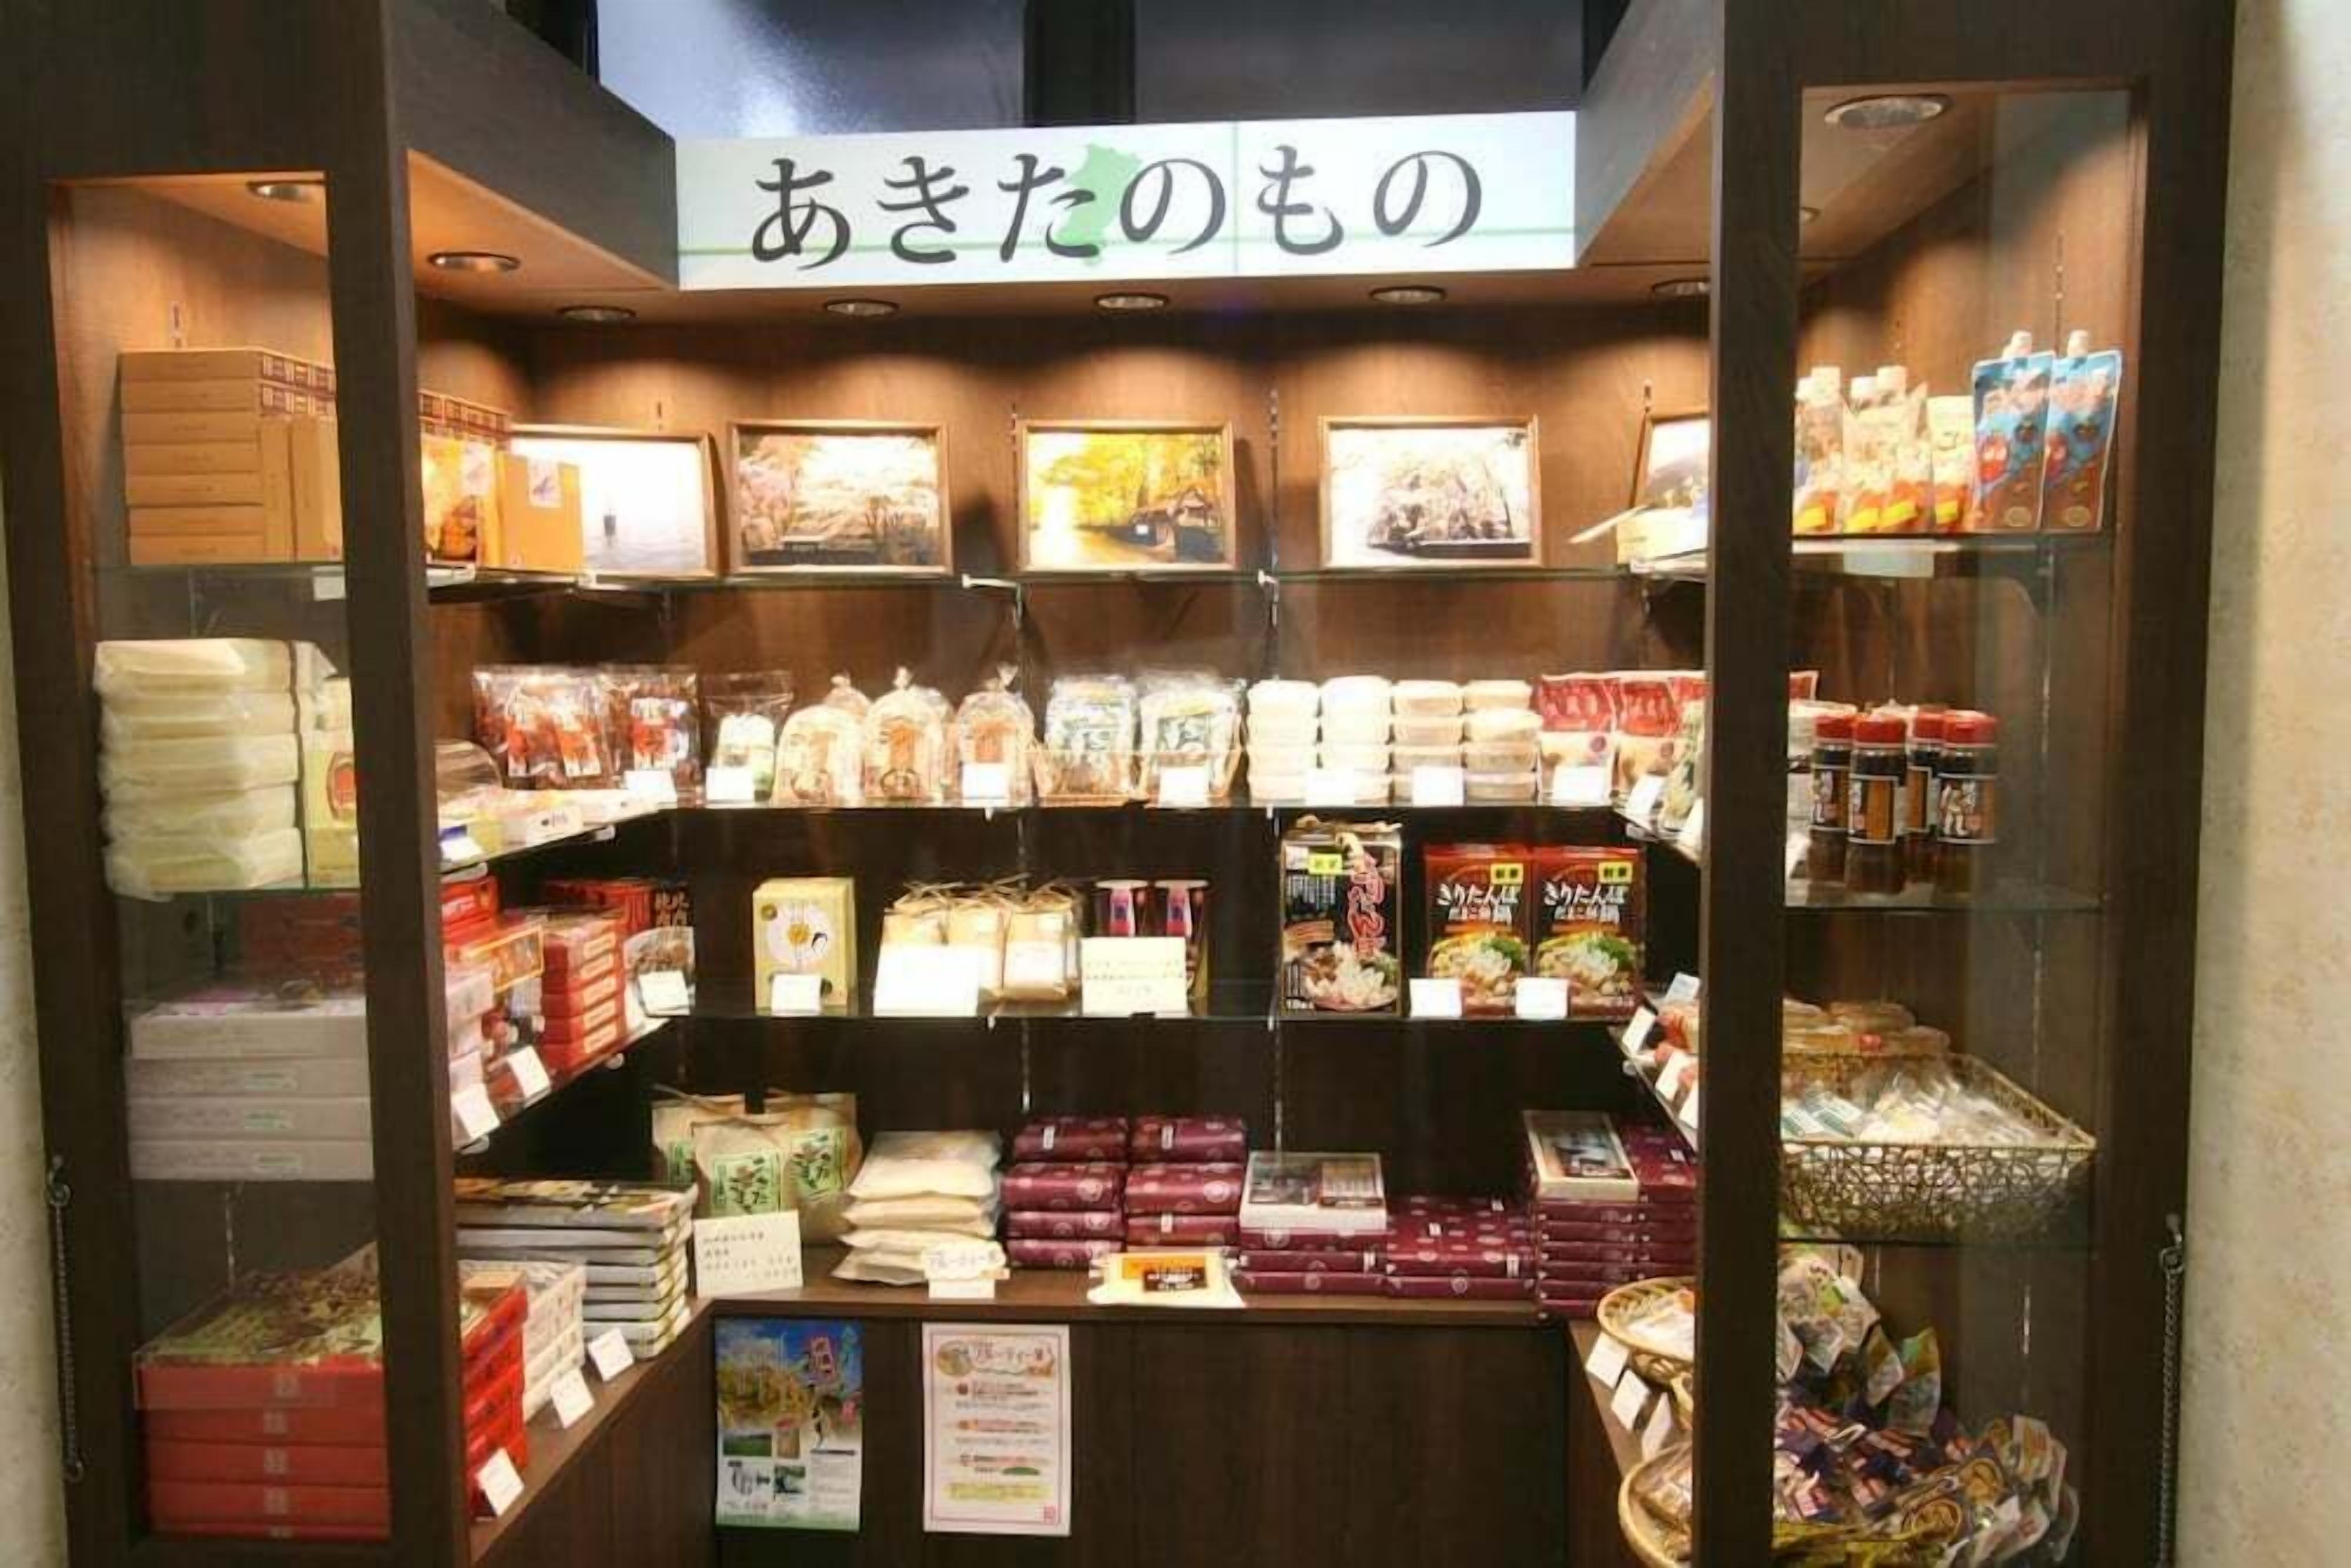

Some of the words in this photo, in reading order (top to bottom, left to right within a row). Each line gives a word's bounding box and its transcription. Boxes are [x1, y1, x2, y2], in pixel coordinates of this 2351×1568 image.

[751, 143, 1482, 271] あきたのもの
